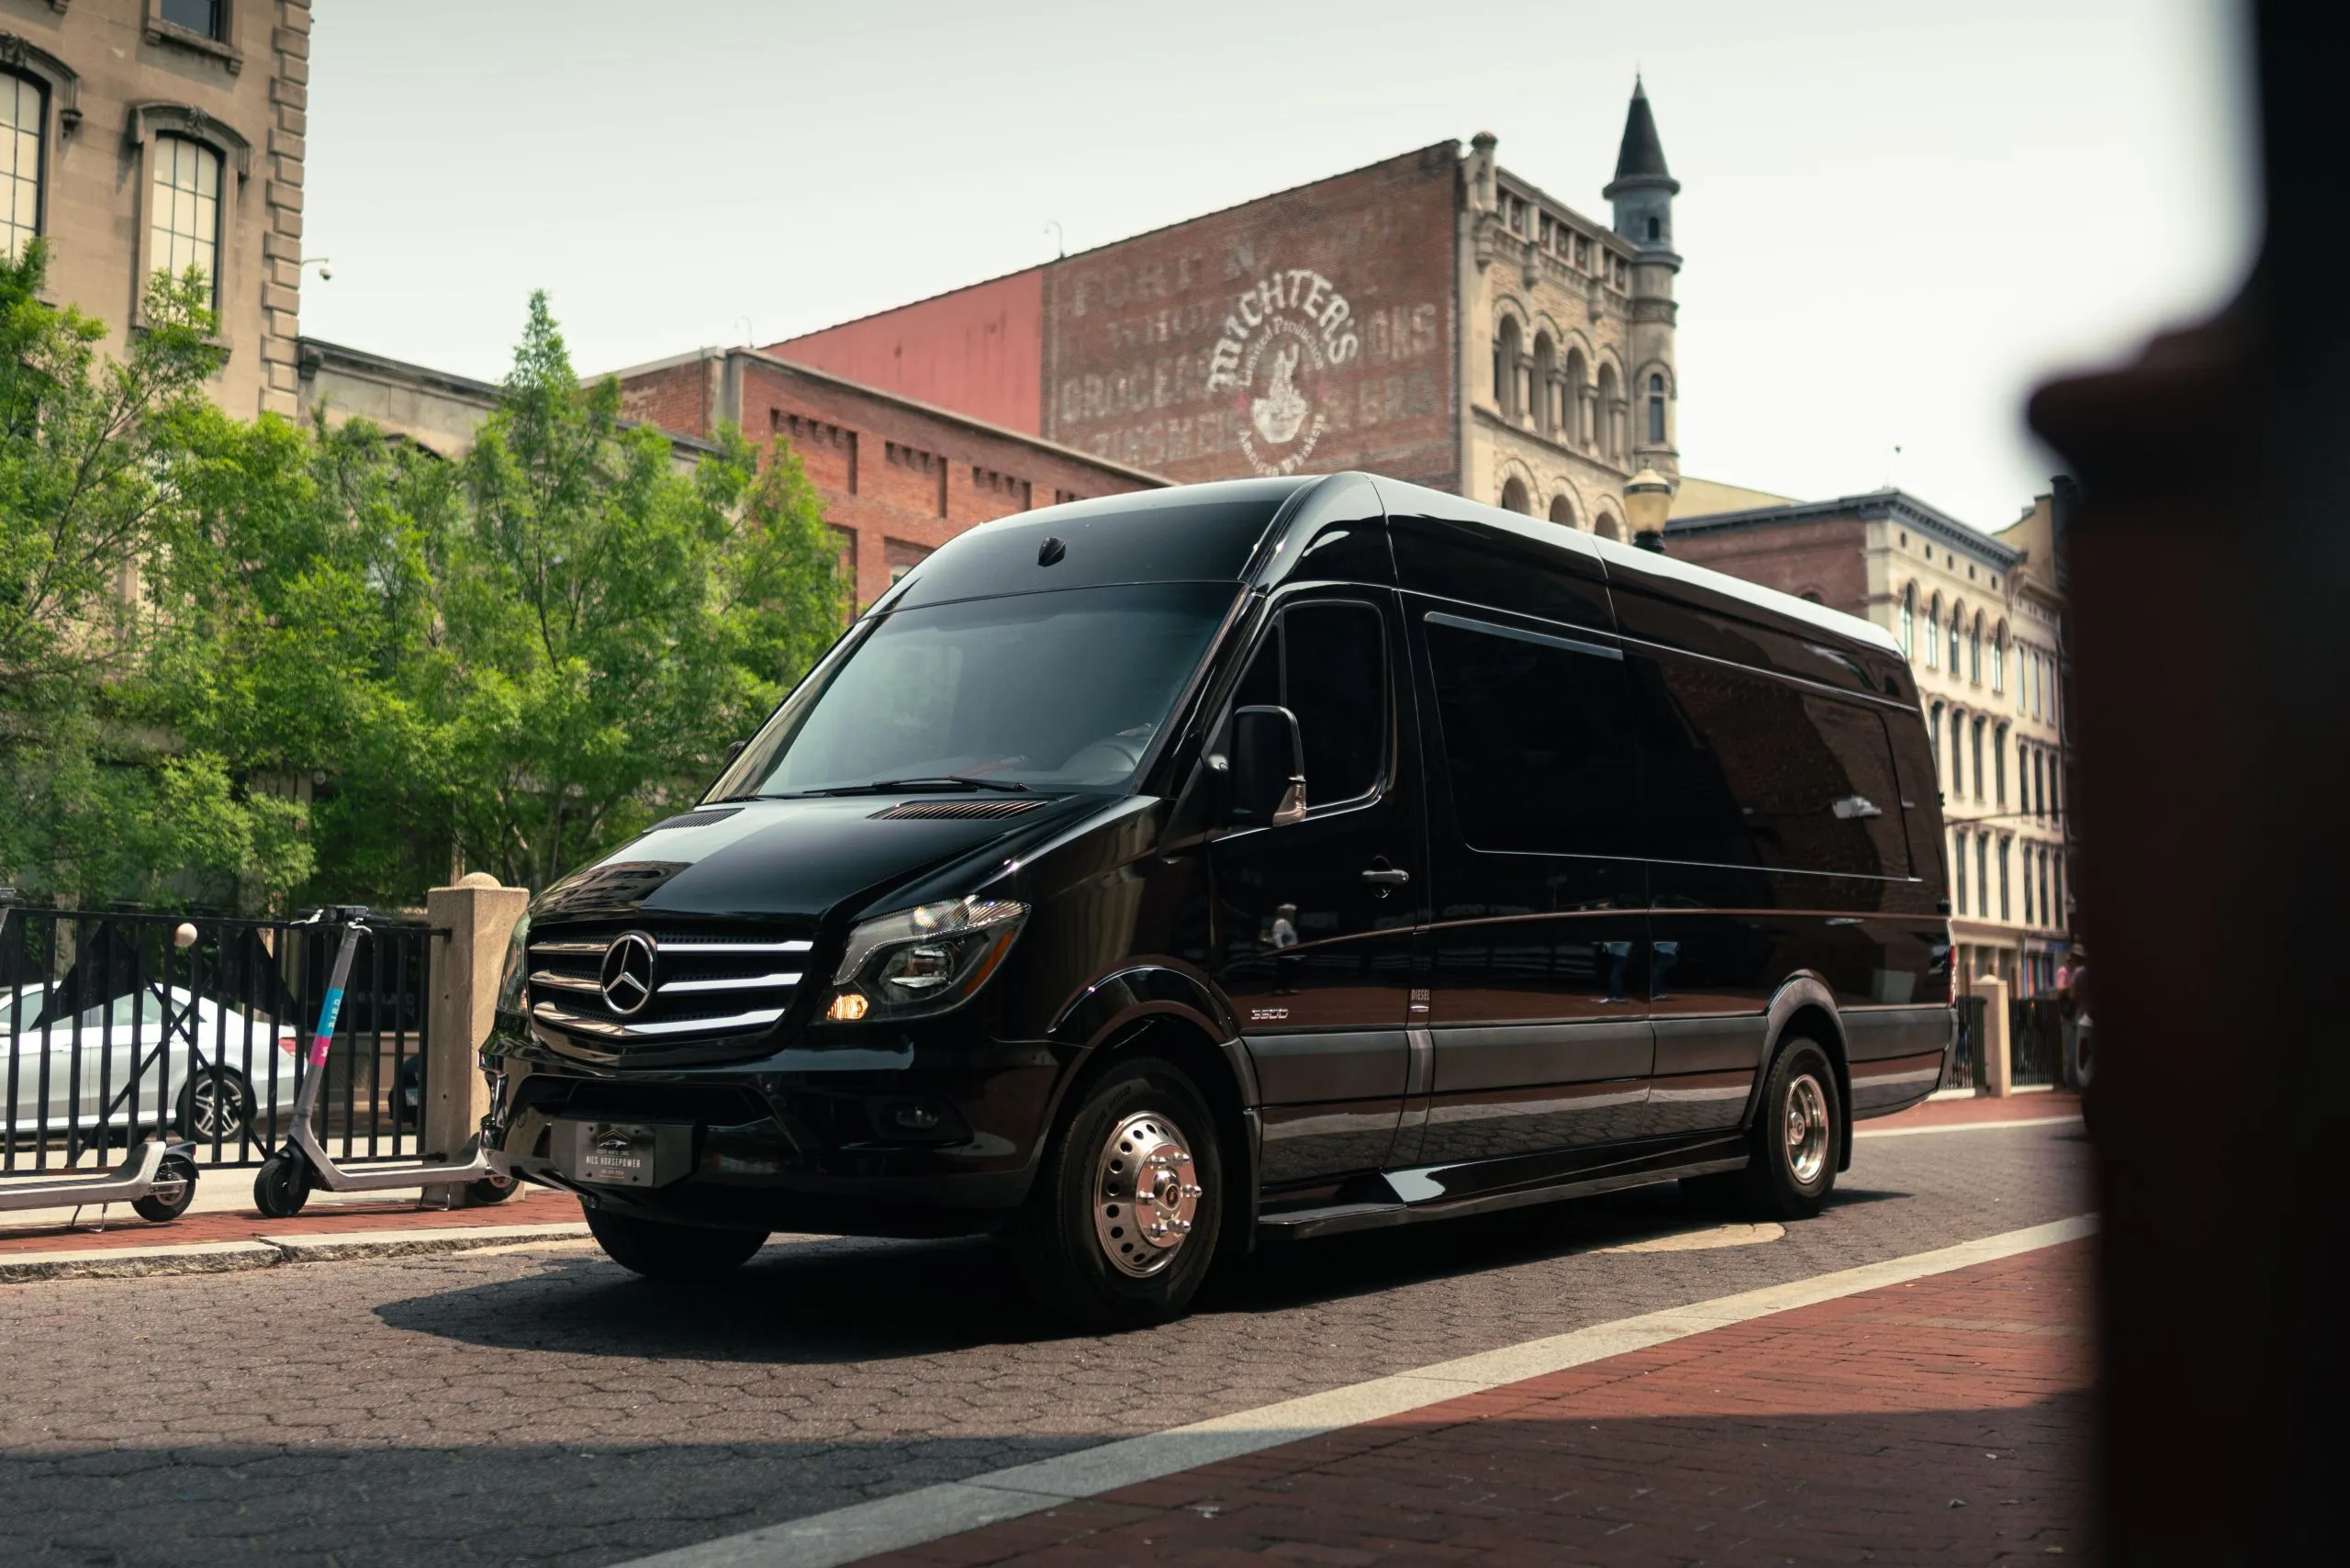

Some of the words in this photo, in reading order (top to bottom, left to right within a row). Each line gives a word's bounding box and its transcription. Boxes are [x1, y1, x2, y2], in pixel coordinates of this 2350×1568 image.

[1273, 314, 1325, 371] Production
[1411, 989, 1430, 1002] DIESEL
[328, 998, 341, 1028] BIRD
